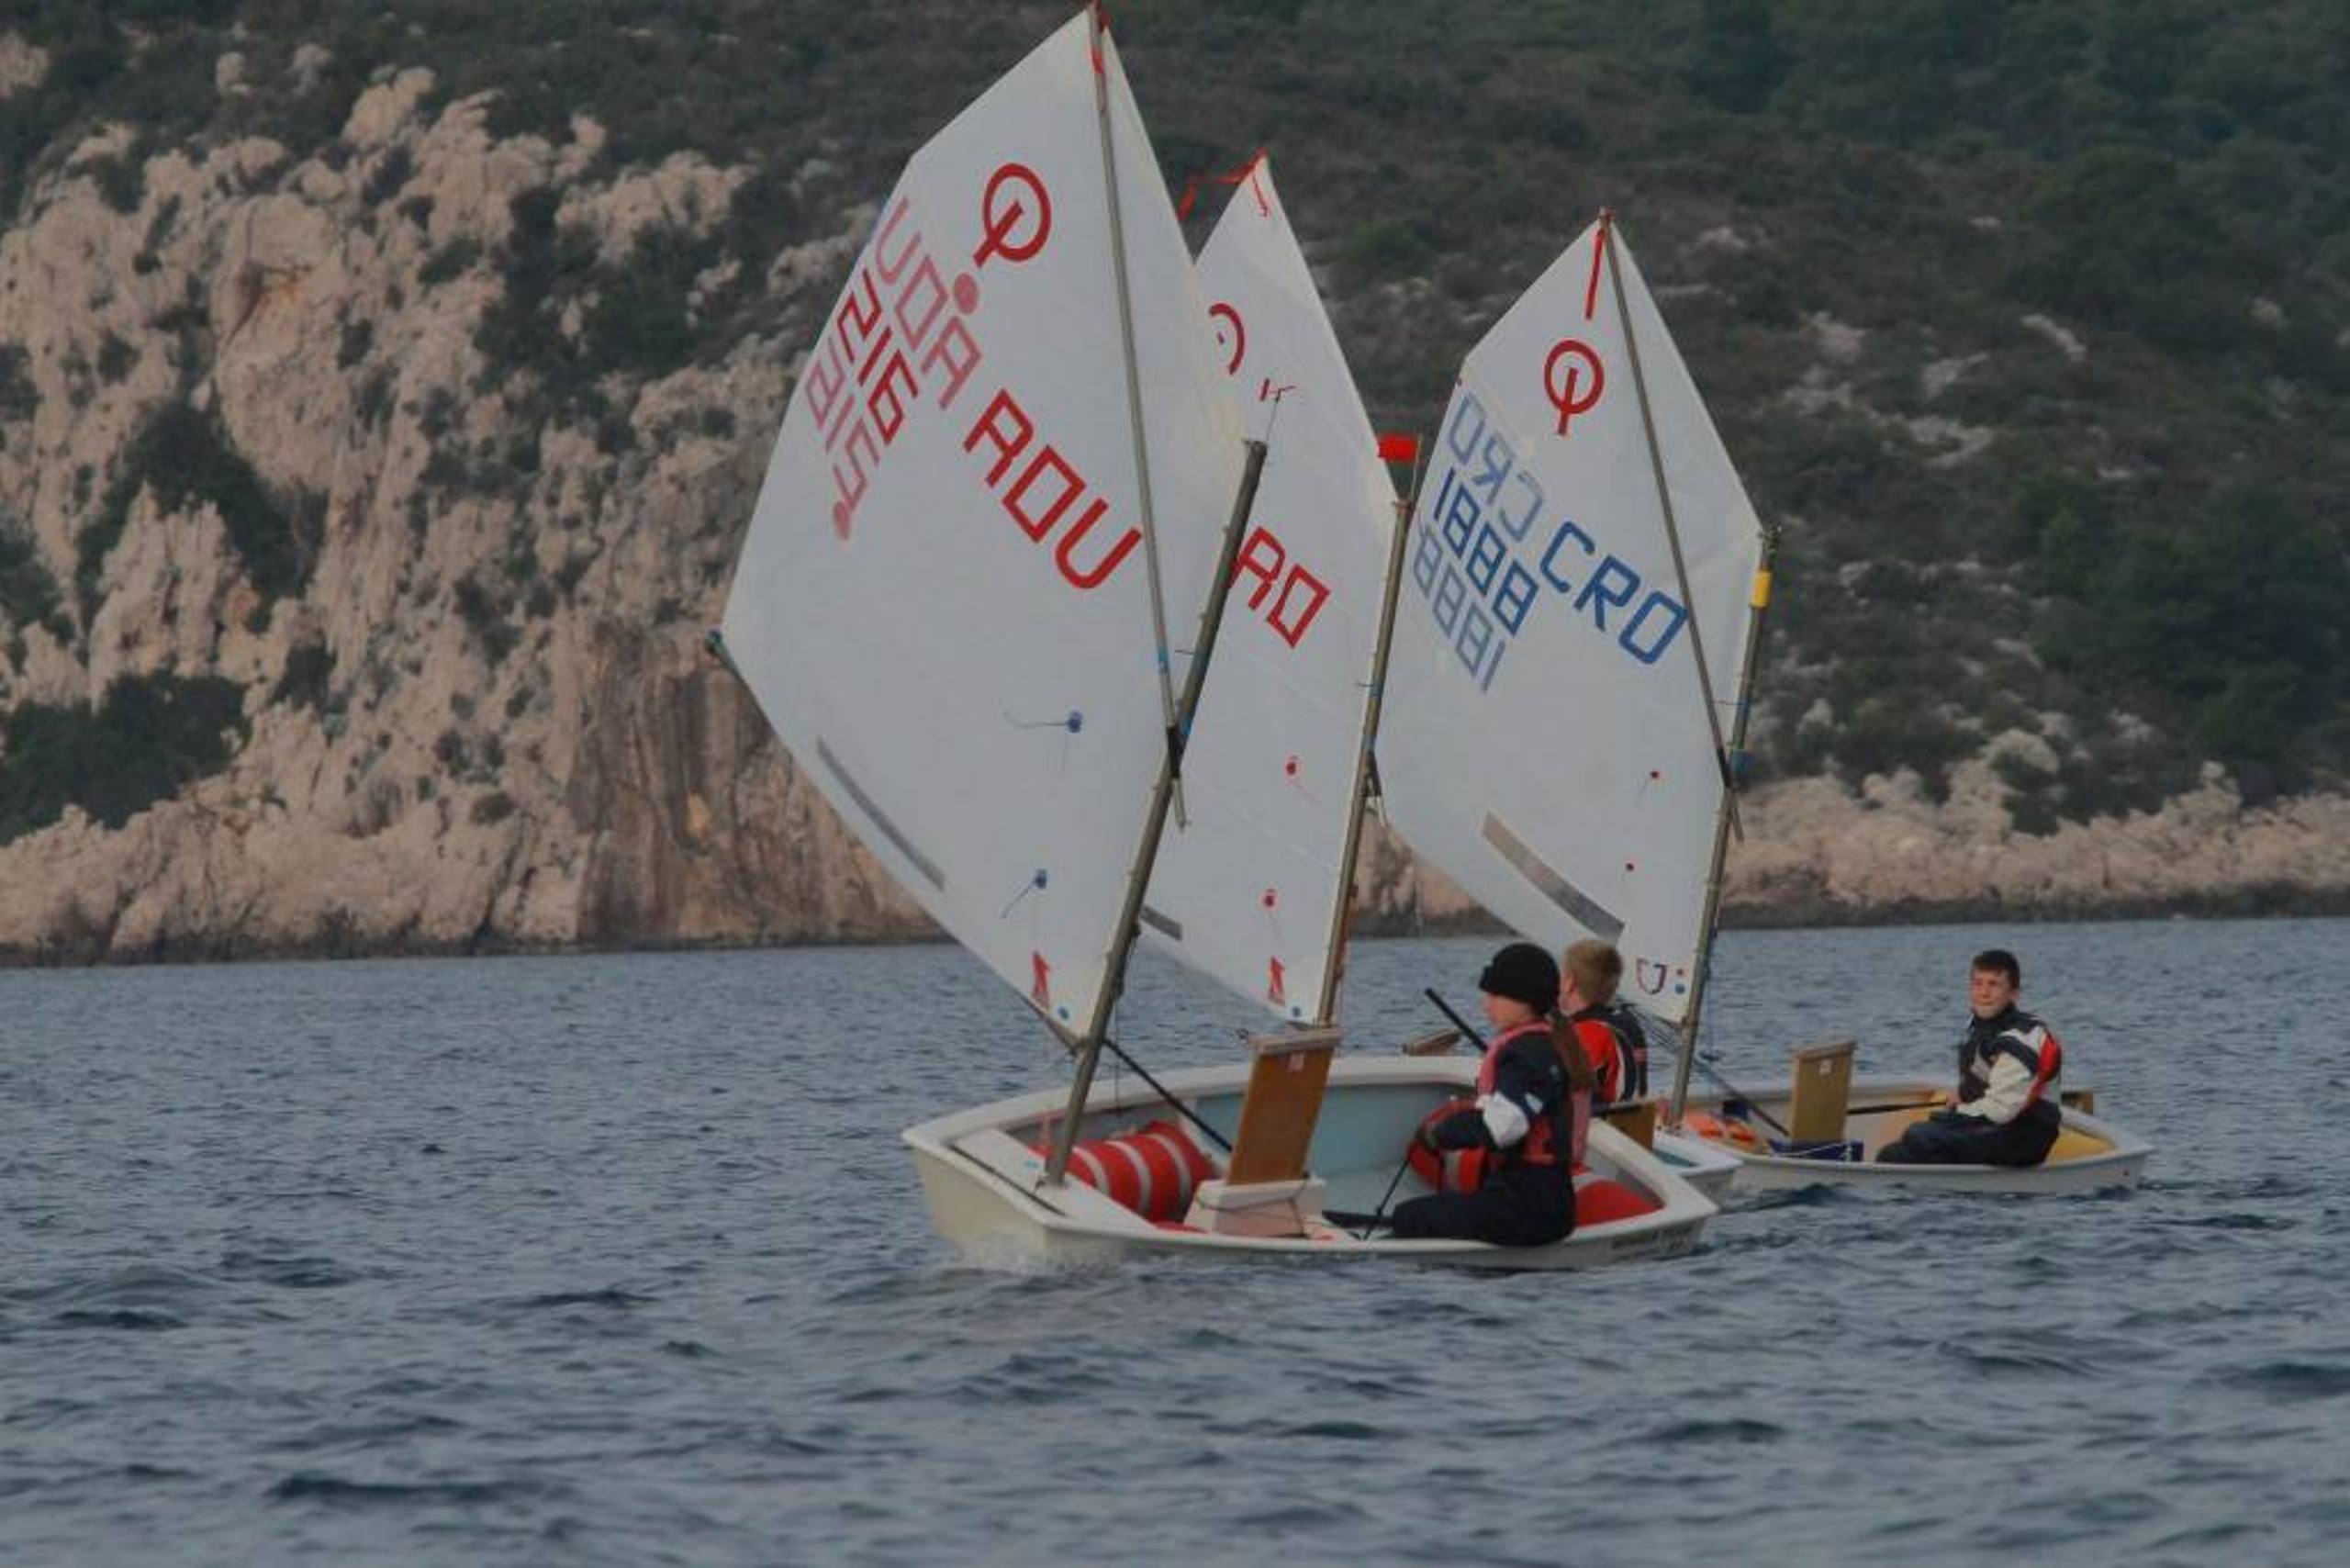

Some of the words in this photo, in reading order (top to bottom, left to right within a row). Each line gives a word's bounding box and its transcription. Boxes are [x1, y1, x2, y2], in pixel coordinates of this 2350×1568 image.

[962, 388, 1142, 589] ROU
[1433, 467, 1539, 638] 1888
[1225, 525, 1331, 649] RO
[1540, 521, 1690, 665] CRO
